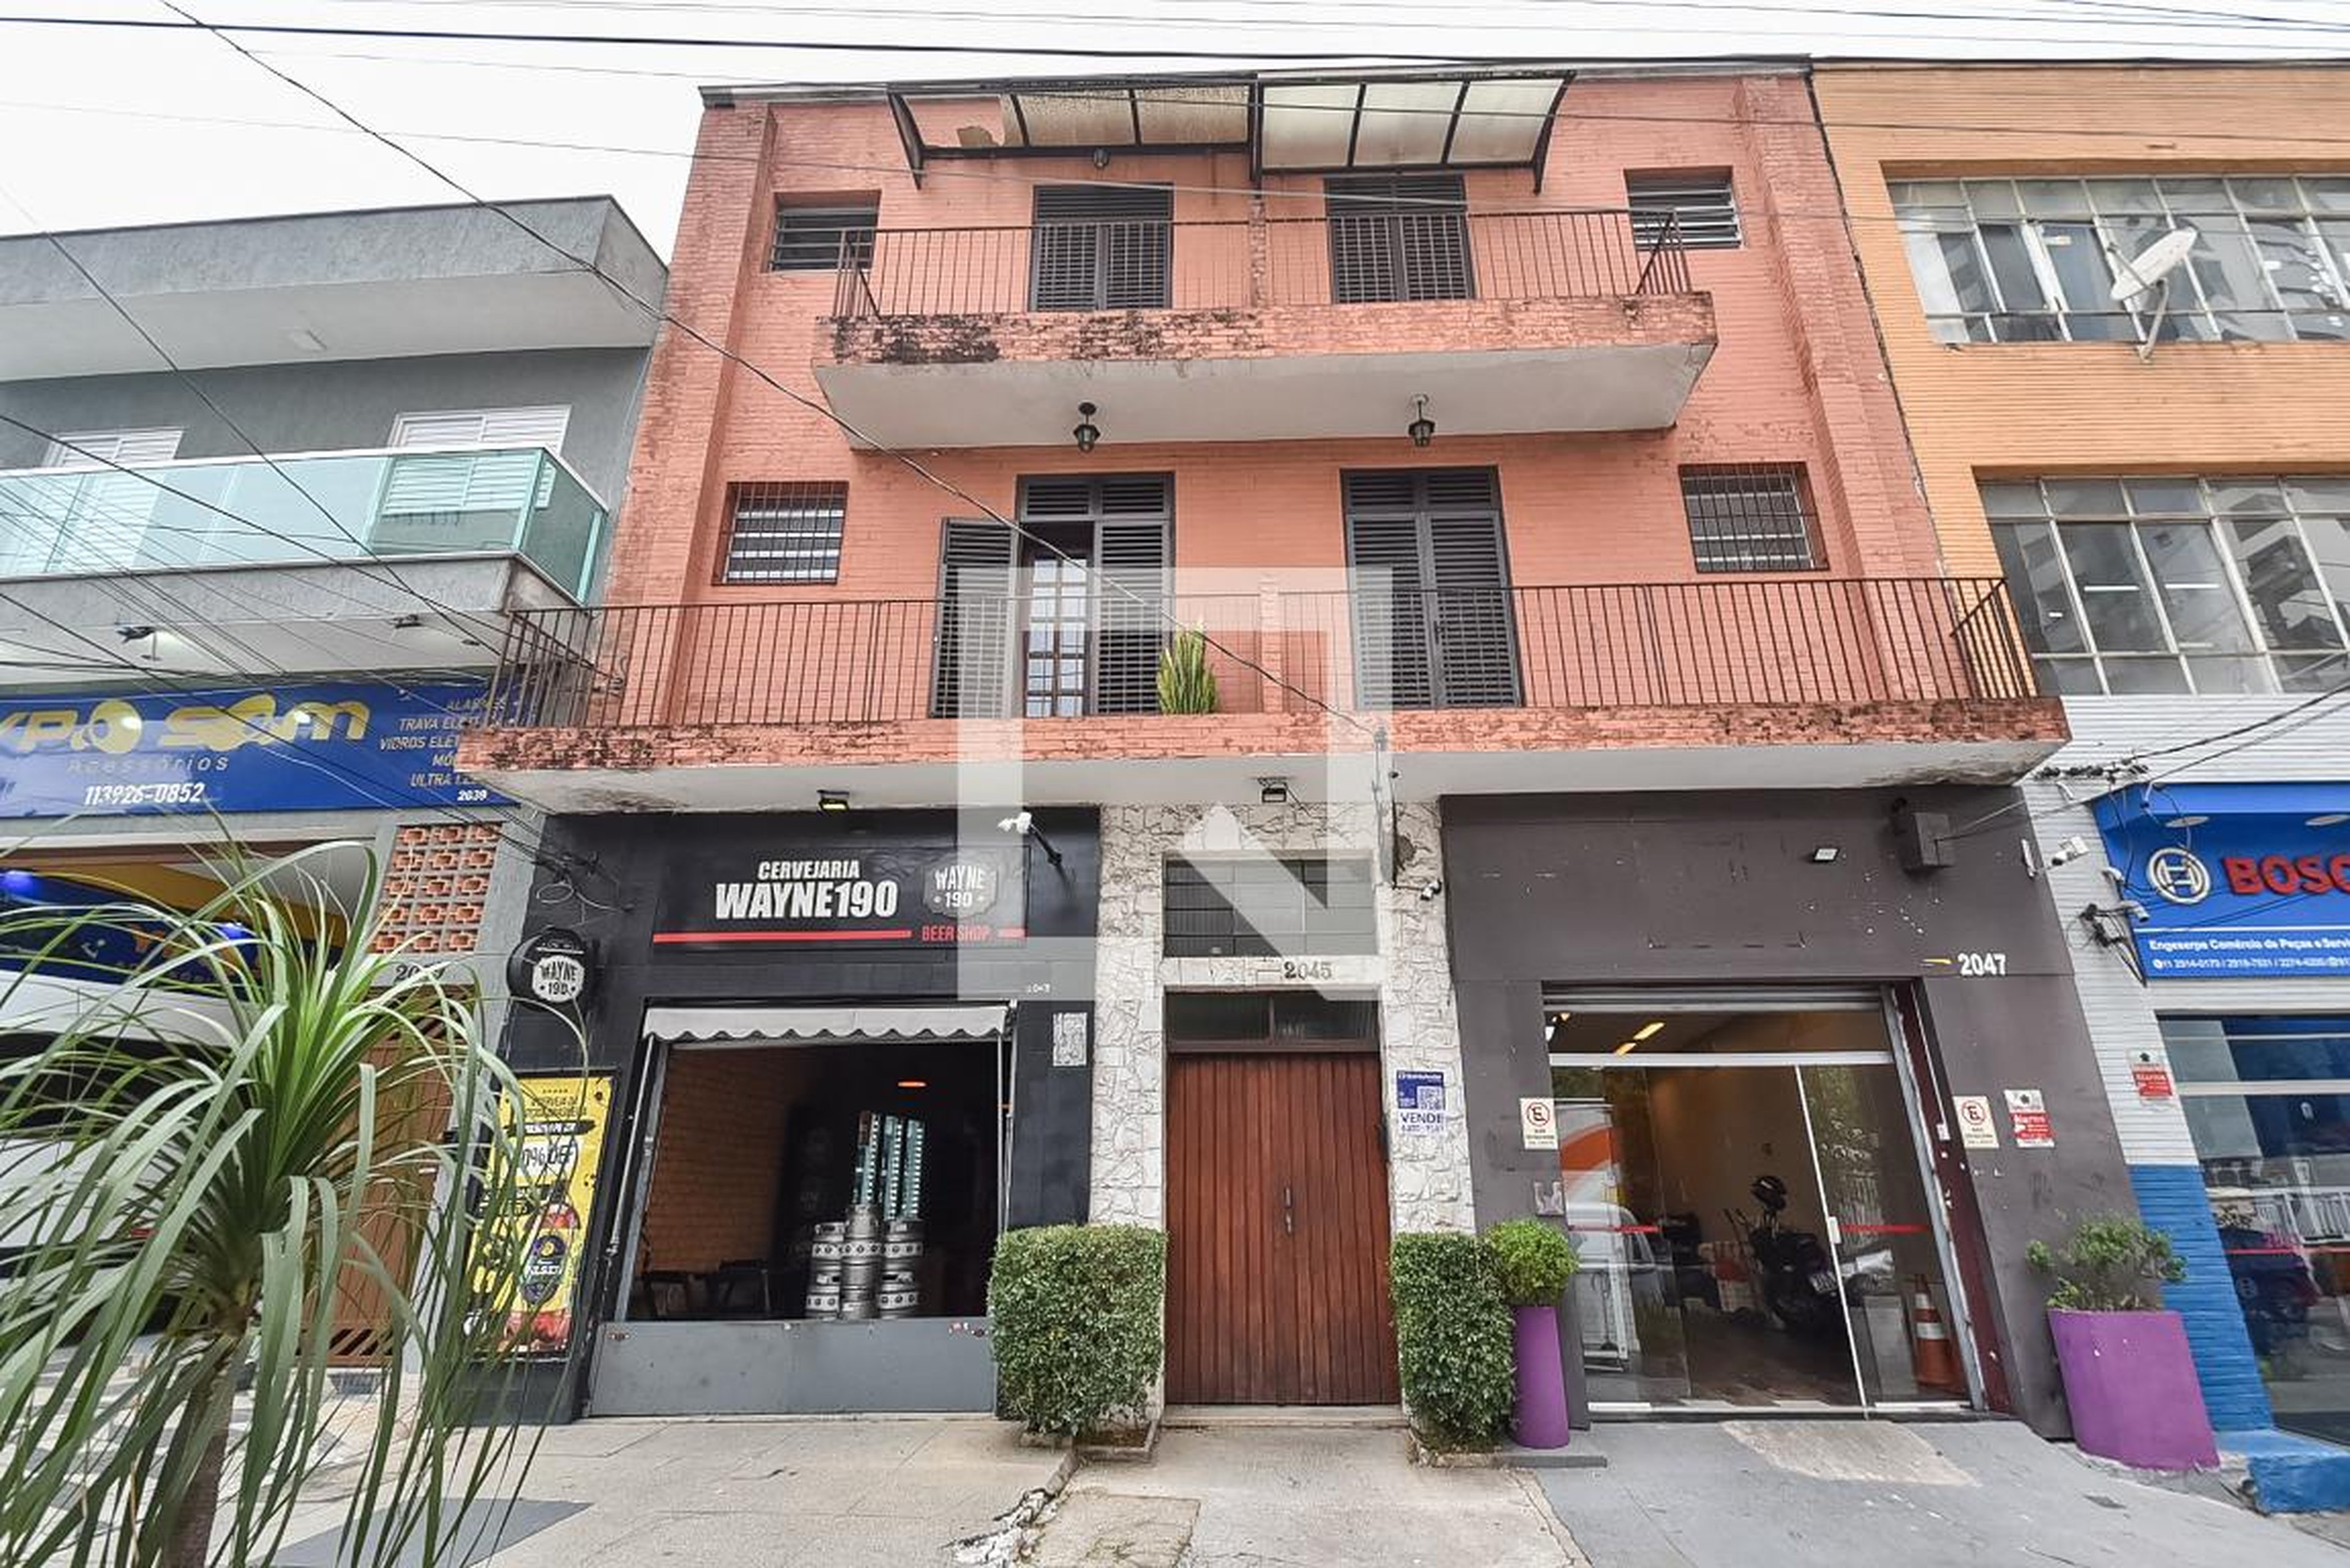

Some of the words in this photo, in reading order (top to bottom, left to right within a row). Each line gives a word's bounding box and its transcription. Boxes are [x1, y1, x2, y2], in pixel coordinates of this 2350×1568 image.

[400, 717, 439, 731] TRAVA
[379, 736, 426, 750] VIDROS
[758, 859, 860, 880] CERVEJARIA
[934, 865, 988, 890] WAYNE
[945, 892, 973, 908] 190
[922, 925, 955, 942] BEER
[957, 925, 991, 941] SHOP
[539, 960, 578, 981] WAYNE
[1283, 960, 1332, 980] 2045
[1957, 952, 2006, 976] 2047
[548, 981, 569, 995] 190
